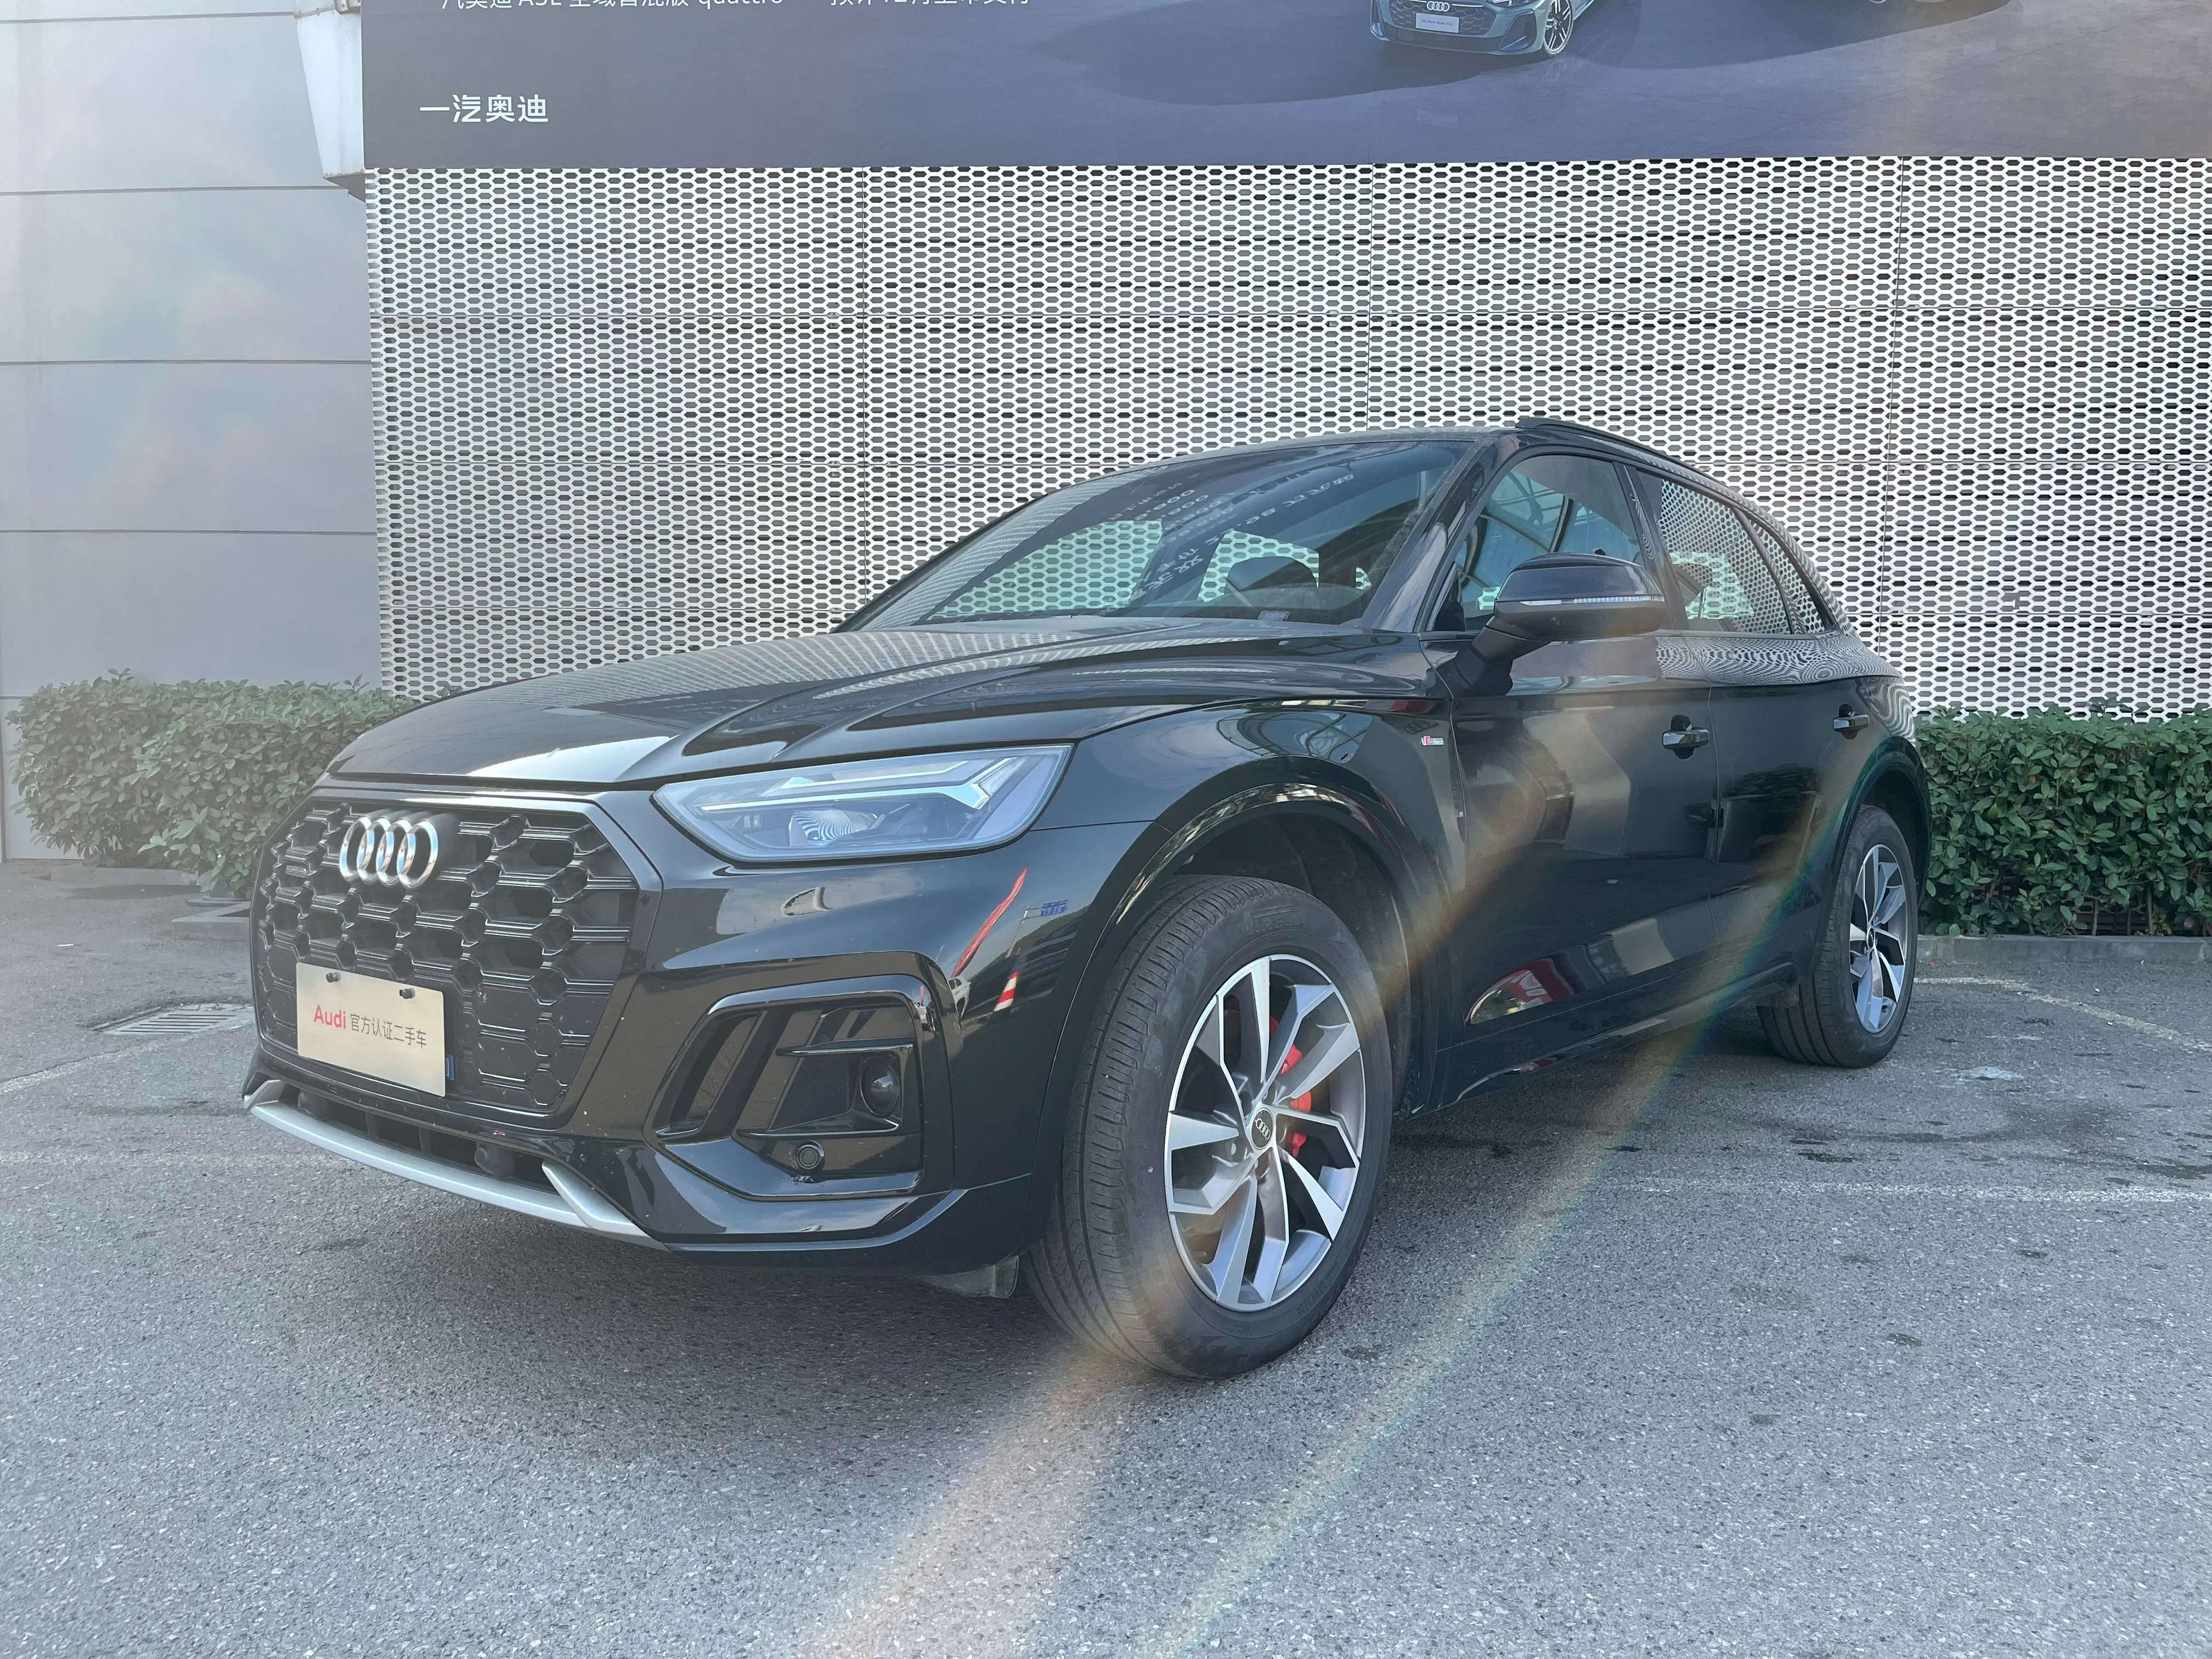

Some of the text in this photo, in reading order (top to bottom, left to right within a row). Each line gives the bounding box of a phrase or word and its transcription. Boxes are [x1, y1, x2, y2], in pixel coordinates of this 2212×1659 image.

[419, 94, 549, 123] 一汽奥迪
[313, 1005, 427, 1049] Audi 官方认证二手车
